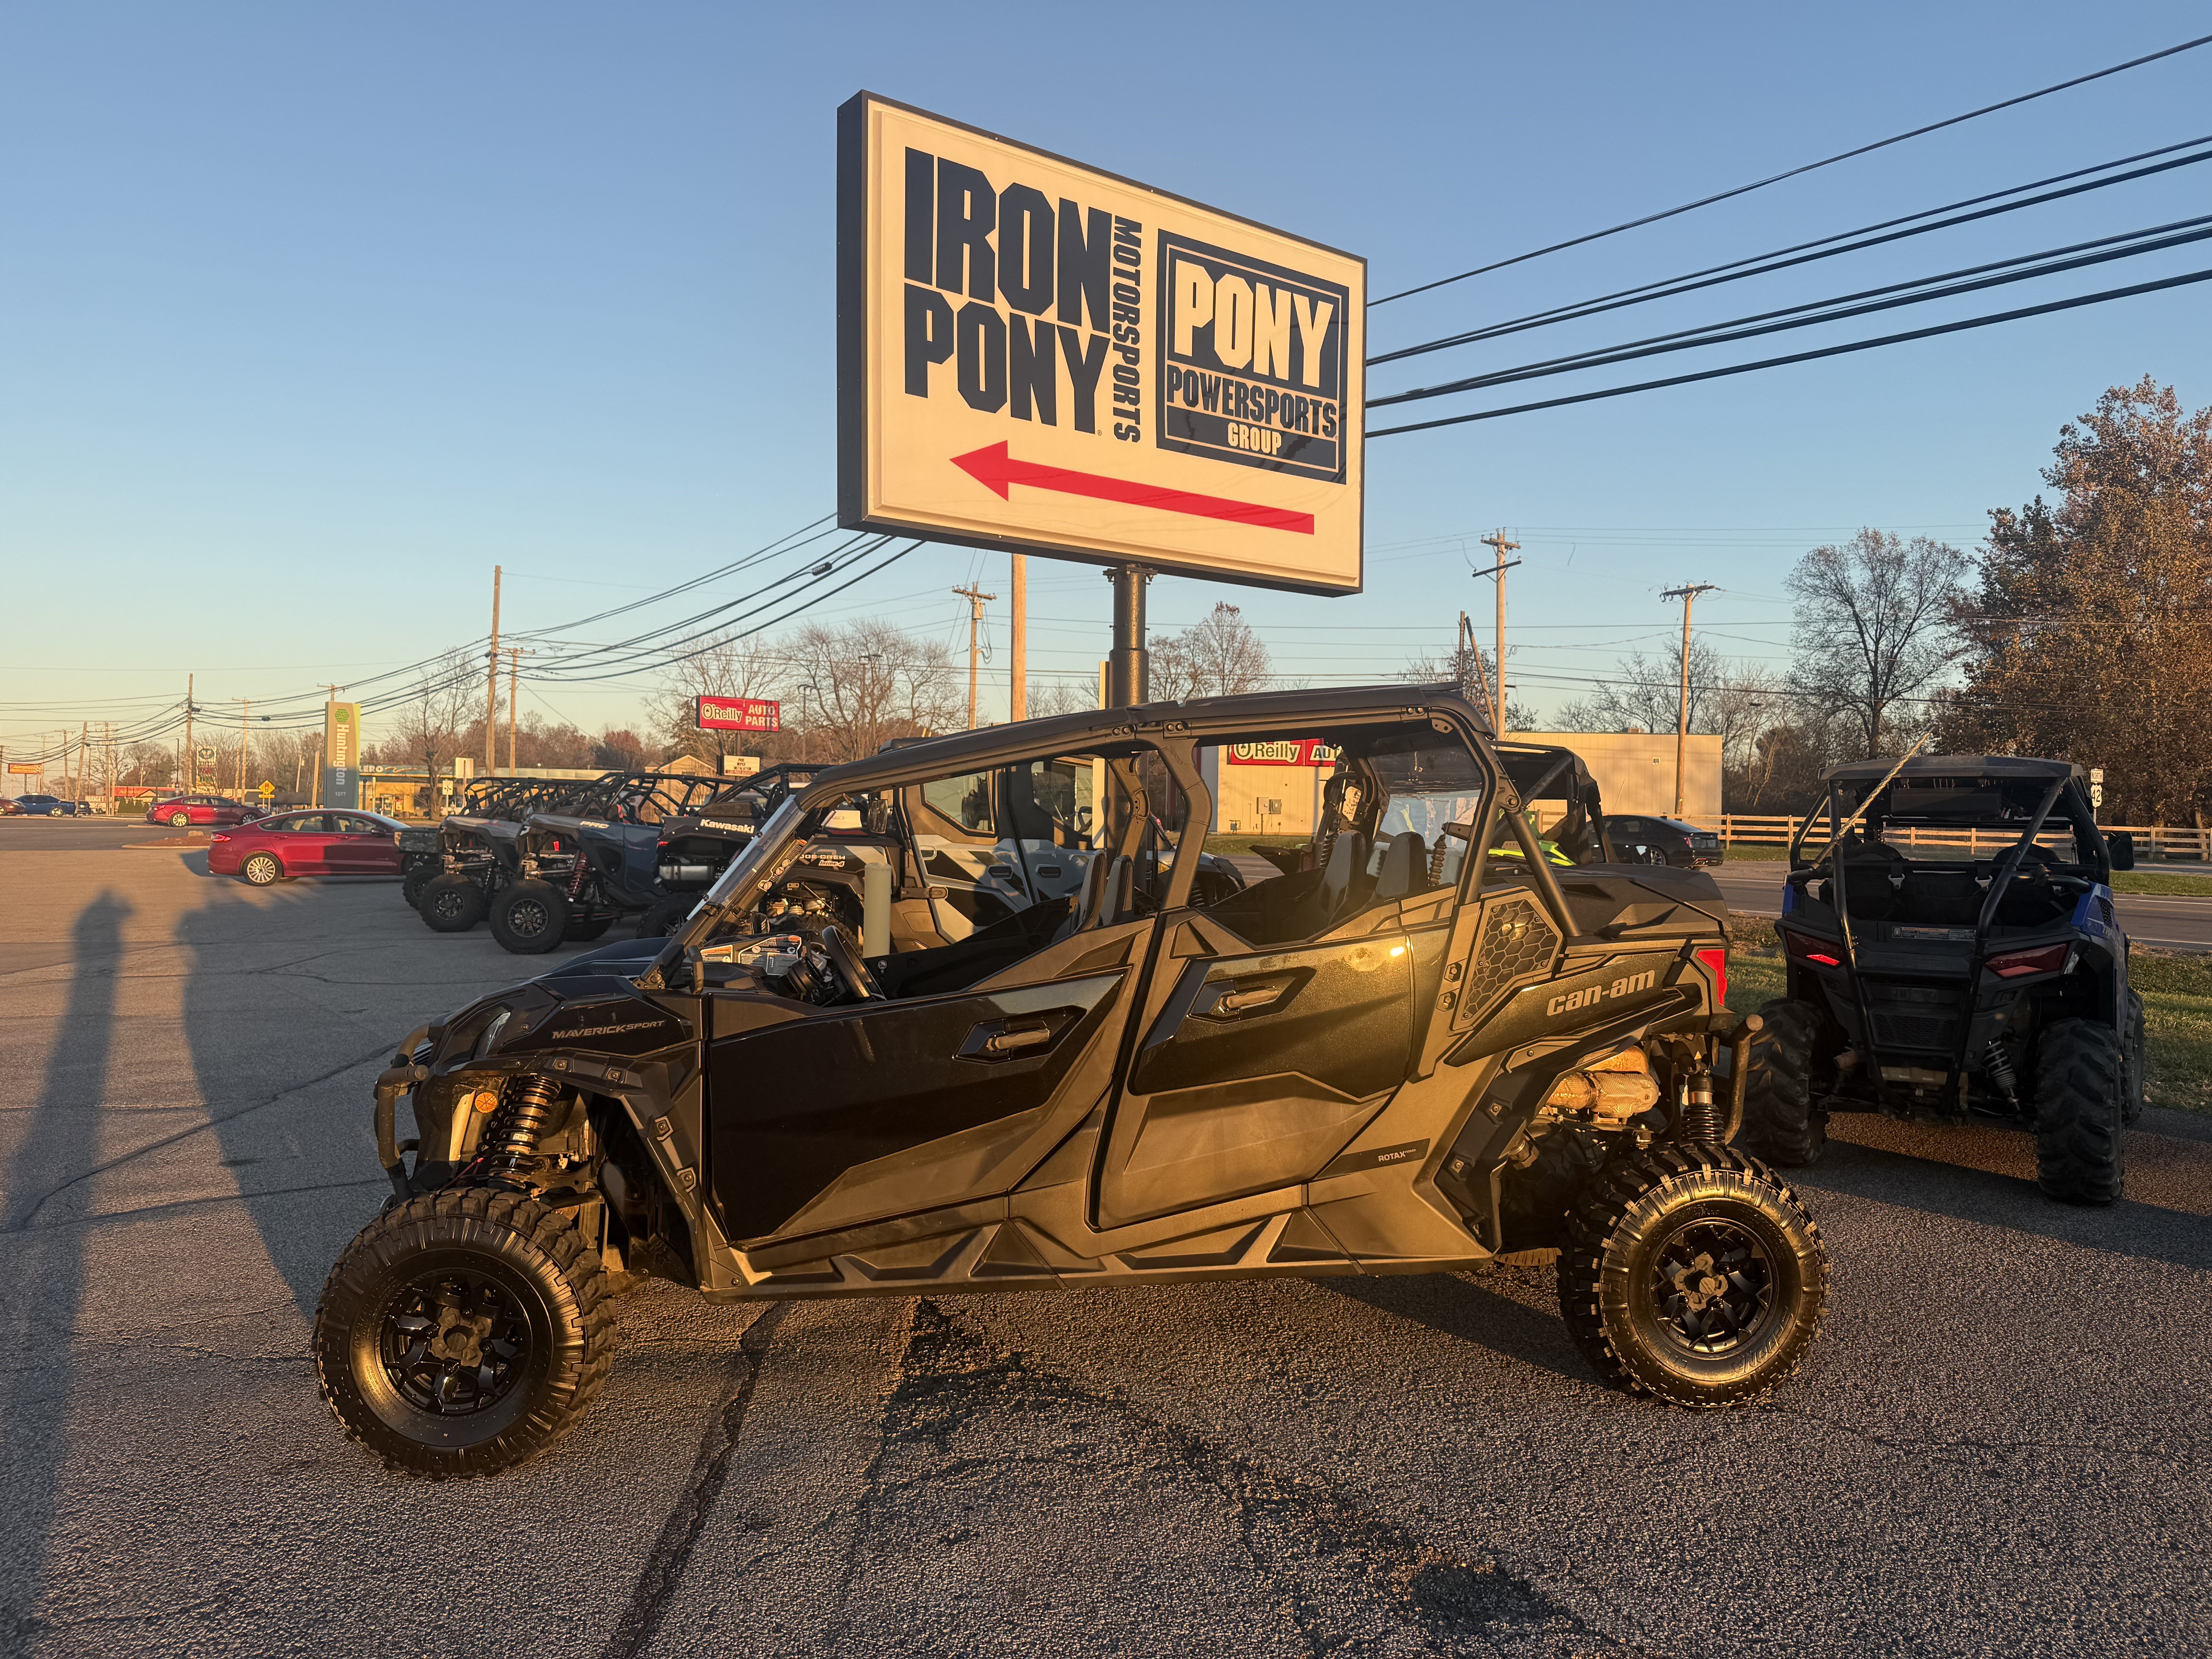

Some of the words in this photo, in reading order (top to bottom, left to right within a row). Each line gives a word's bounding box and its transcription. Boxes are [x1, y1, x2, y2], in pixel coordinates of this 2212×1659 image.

[905, 146, 1112, 335] IRON
[1113, 215, 1142, 443] MOTORSPORTS
[1175, 259, 1334, 388] PONY
[905, 282, 1111, 434] PONY
[1167, 364, 1337, 438] POWERSPORTS
[1228, 422, 1282, 455] GROUP
[702, 704, 742, 722] O'Reilly
[748, 704, 775, 716] AUTO
[745, 716, 778, 727] PARTS
[333, 724, 349, 785] Huntington
[1313, 747, 1340, 759] AUT
[2092, 789, 2100, 802] 42
[580, 821, 610, 829] PRO
[700, 819, 755, 834] Kawasaki
[1547, 970, 1655, 1016] can-am
[553, 1025, 626, 1039] MAVERICK
[626, 1020, 666, 1030] SPORT
[1378, 1151, 1406, 1162] ROTAX
